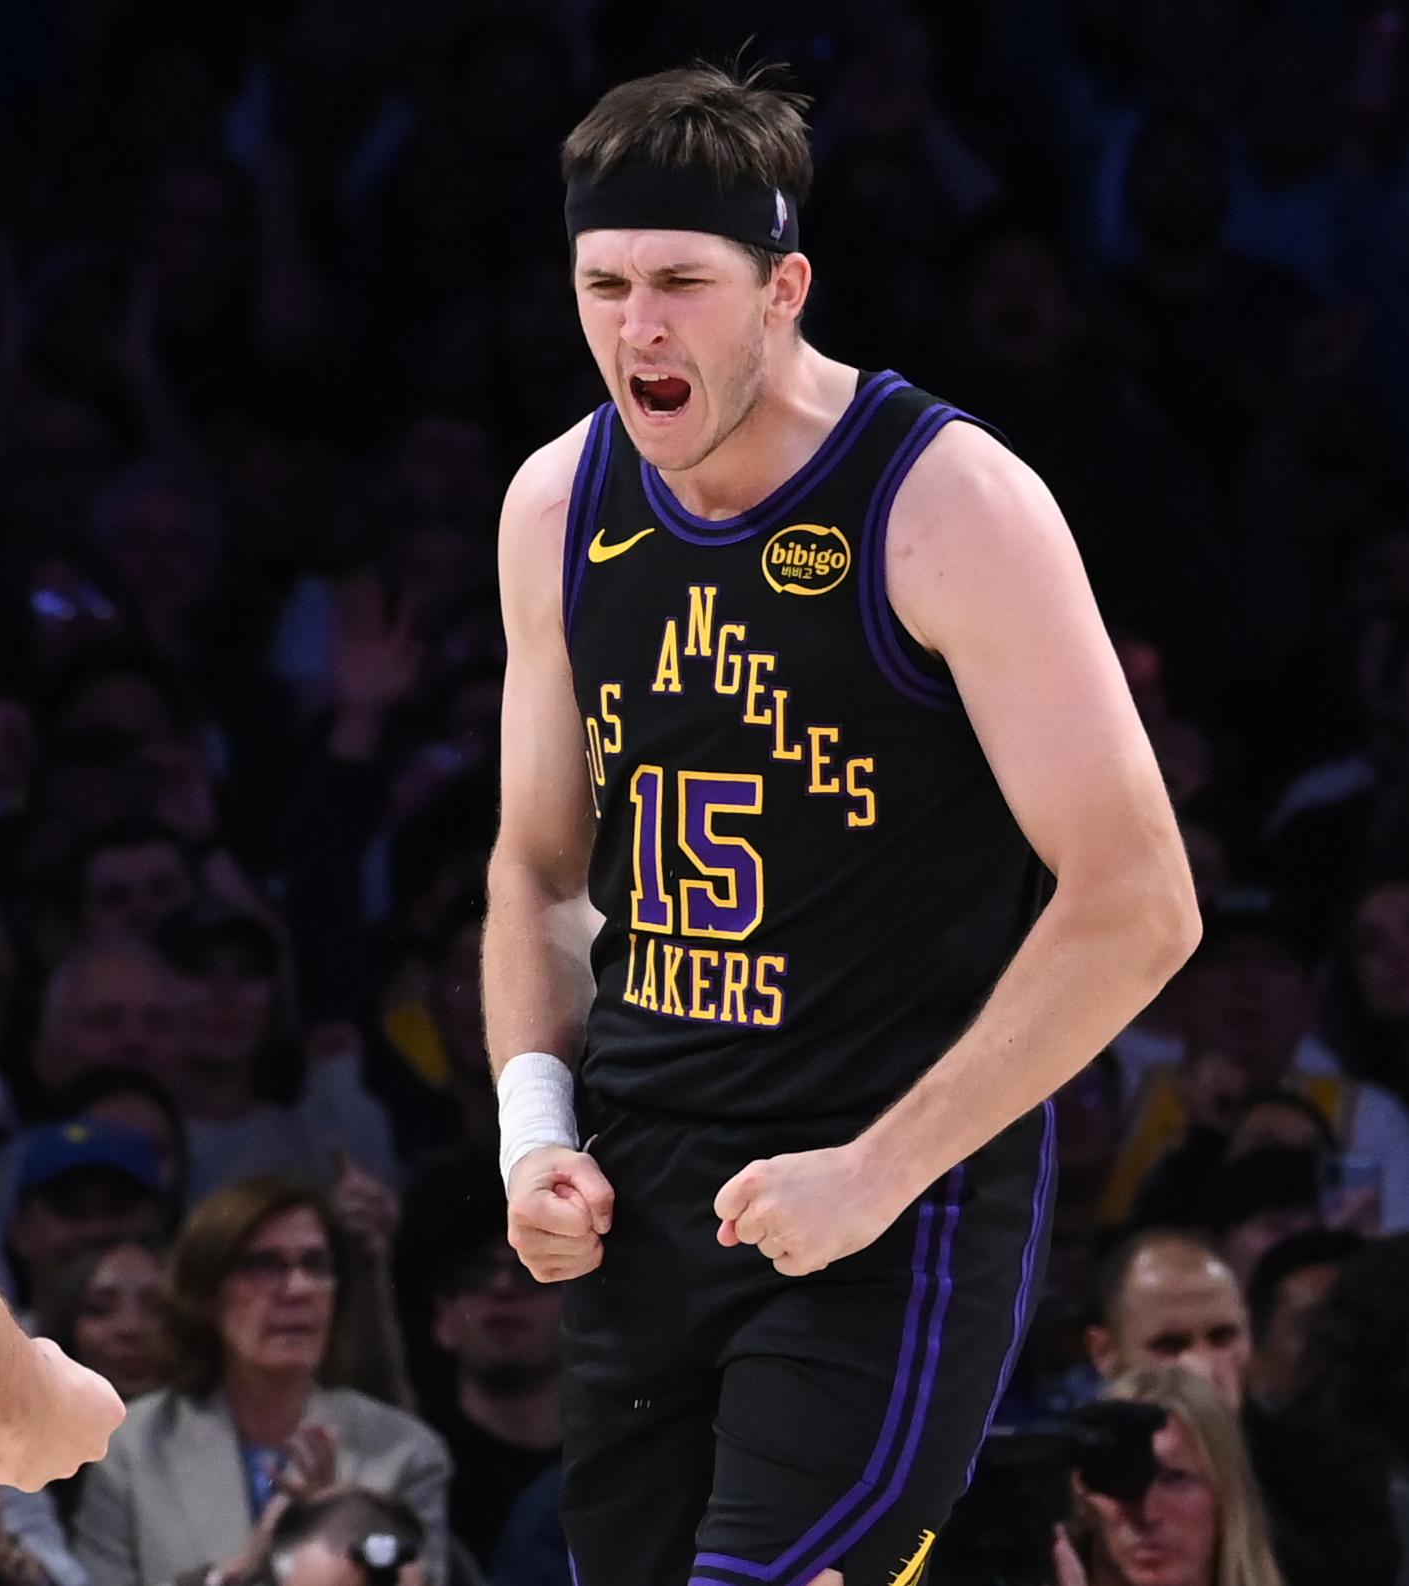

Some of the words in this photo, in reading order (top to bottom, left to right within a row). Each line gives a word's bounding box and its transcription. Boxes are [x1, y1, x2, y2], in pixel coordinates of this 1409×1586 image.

[771, 541, 846, 575] bibigo
[781, 565, 813, 579] 비비고
[585, 682, 624, 820] OS
[651, 586, 876, 827] ANGELES
[628, 764, 765, 940] 15
[622, 933, 787, 1028] LAKERS
